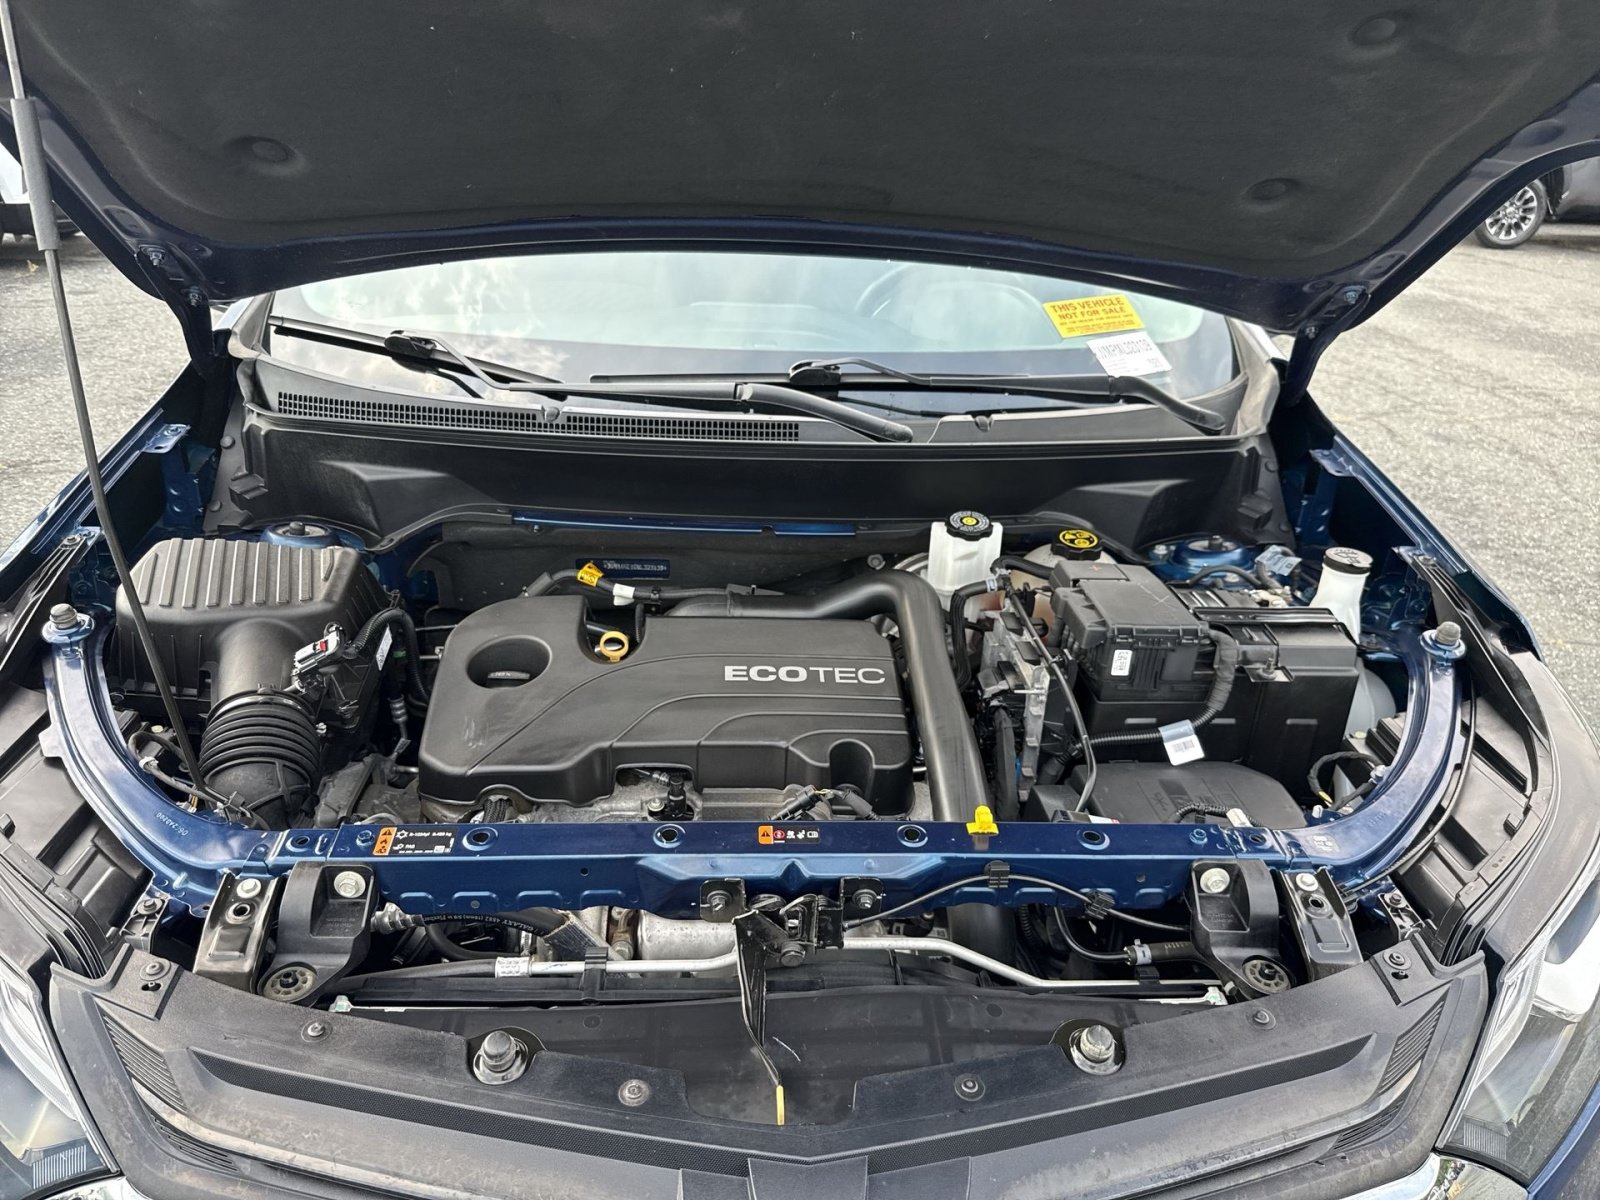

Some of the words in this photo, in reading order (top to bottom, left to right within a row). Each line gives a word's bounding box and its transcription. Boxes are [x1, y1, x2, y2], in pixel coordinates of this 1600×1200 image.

[1050, 302, 1078, 314] THIS
[1079, 297, 1125, 310] VEHICLE
[1058, 311, 1079, 321] NOT
[1081, 309, 1100, 317] FOR
[1102, 306, 1127, 315] SALE
[724, 665, 886, 685] ECOTEC
[501, 919, 534, 931] GALAXY
